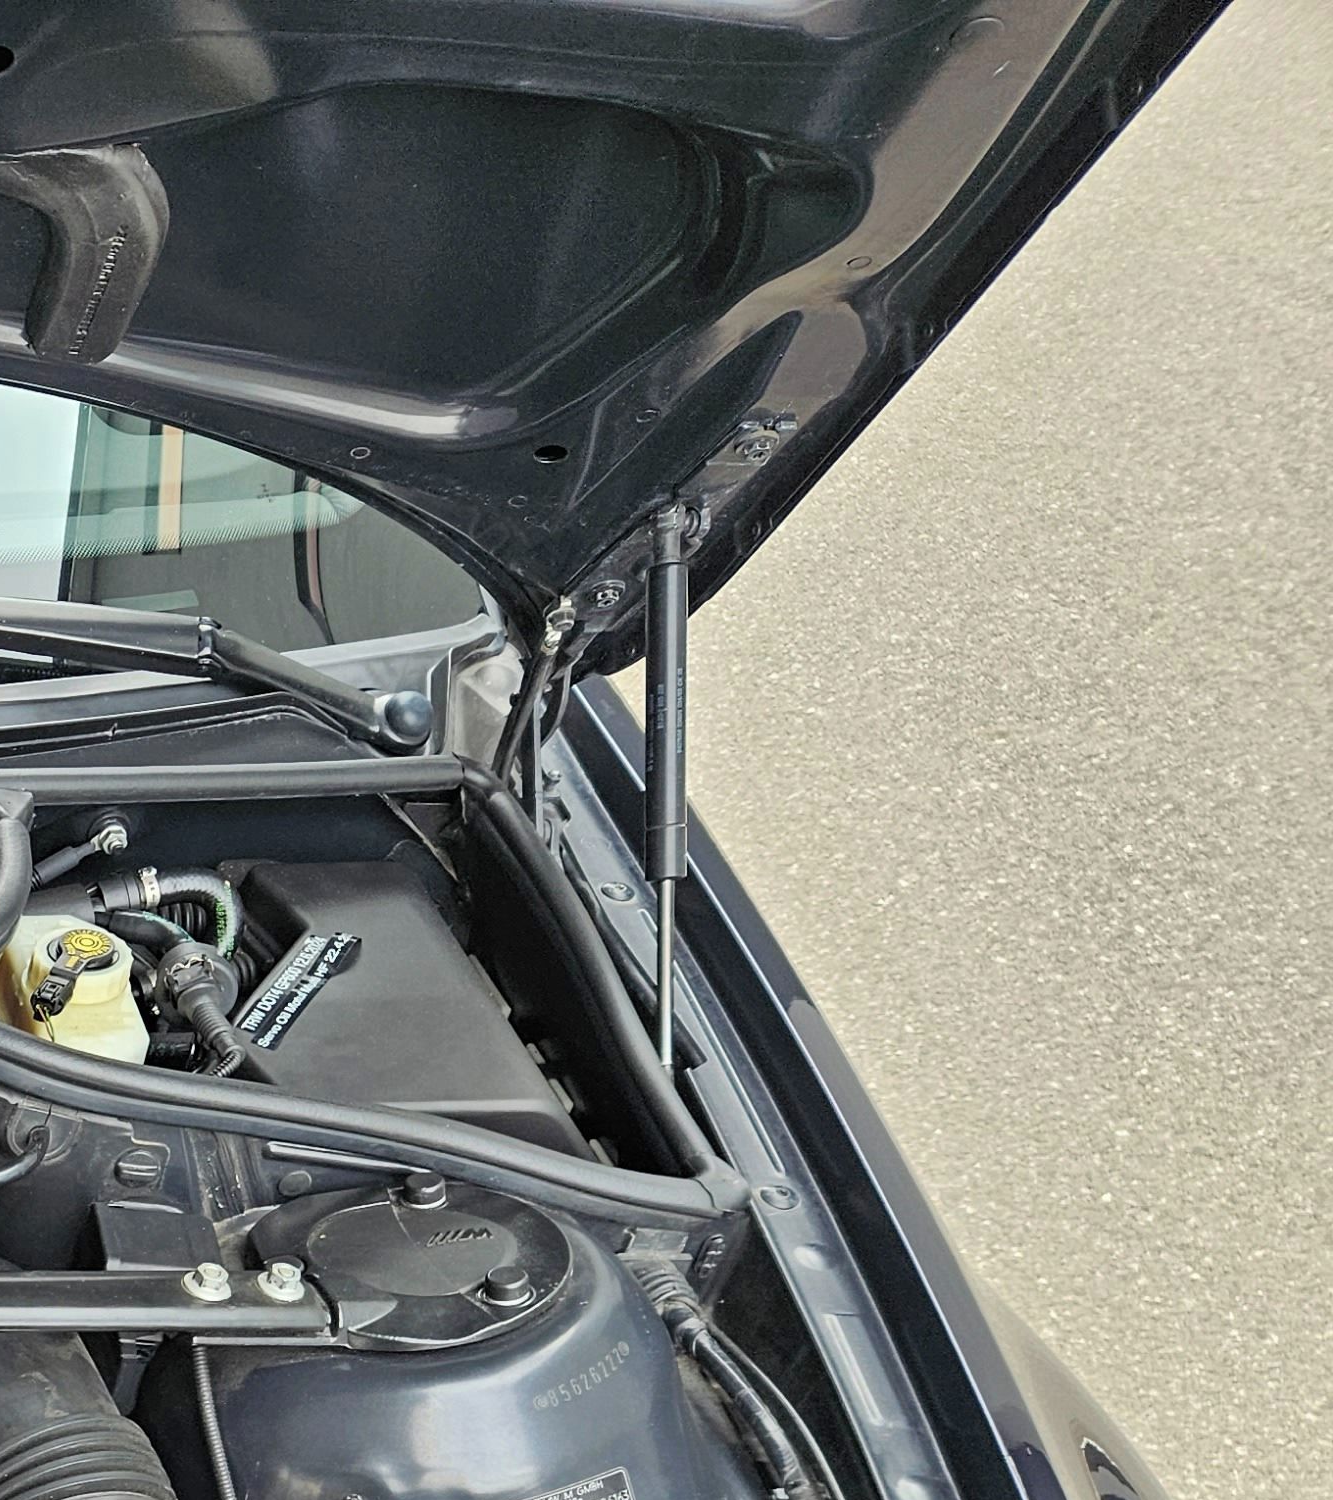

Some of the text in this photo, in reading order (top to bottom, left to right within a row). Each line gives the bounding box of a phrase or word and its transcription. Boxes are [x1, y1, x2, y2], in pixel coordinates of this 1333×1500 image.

[241, 1008, 266, 1031] TRW
[256, 988, 284, 1012] DOT4
[257, 1024, 282, 1047] Servo
[314, 962, 330, 978] HF
[564, 1490, 574, 1500] M
[576, 1481, 604, 1496] GMBH
